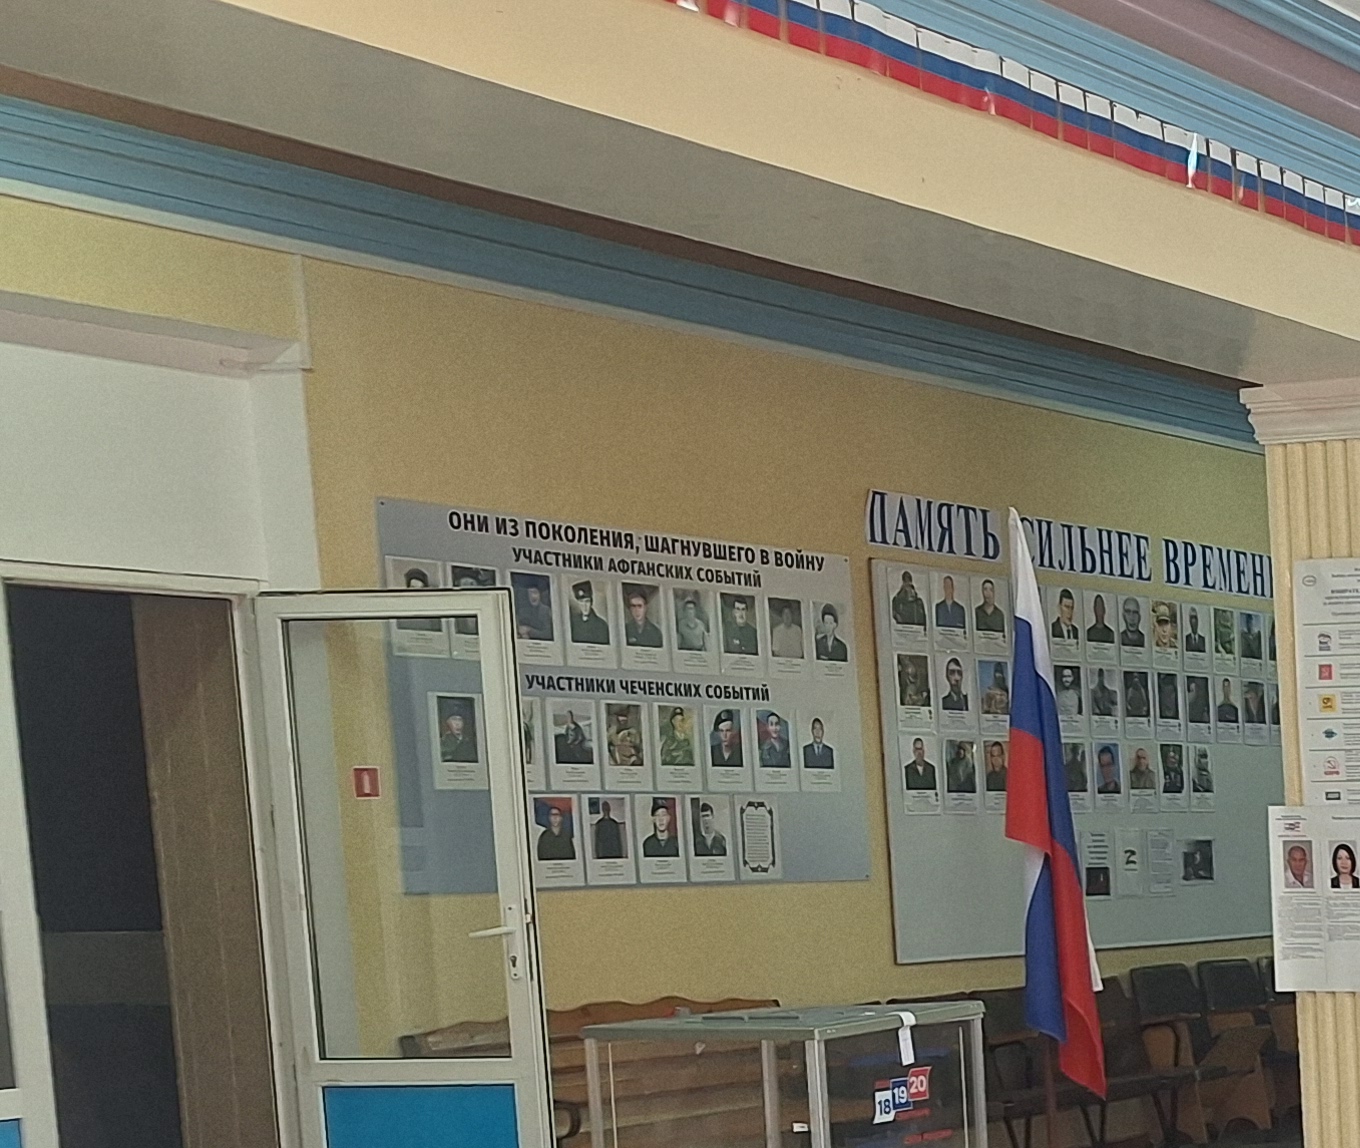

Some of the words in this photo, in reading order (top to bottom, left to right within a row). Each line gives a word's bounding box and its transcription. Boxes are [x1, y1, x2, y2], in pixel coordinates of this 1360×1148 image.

[448, 511, 489, 534] ОНИ
[495, 517, 519, 538] ИЗ
[525, 519, 640, 553] ПОКОЛЕНИЯ,
[644, 534, 756, 566] ШАГНУВШЕГО
[760, 549, 770, 567] В
[774, 548, 825, 572] ВОЙНУ
[868, 491, 1001, 560] ПАМЯТЬ
[1021, 516, 1152, 582] СИЛЬНЕЕ
[511, 547, 605, 572] УЧАСТНИКИ
[608, 558, 693, 581] АФГАНСКИХ
[696, 566, 762, 588] СОБЫТИЙ
[525, 674, 616, 694] УЧАСТНИКИ
[619, 679, 702, 699] ЧЕЧЕНСКИХ
[706, 683, 770, 702] СОБЫТИЙ
[1124, 849, 1137, 865] 2
[878, 1099, 891, 1115] 18
[893, 1086, 907, 1104] 19
[909, 1075, 926, 1094] 20
